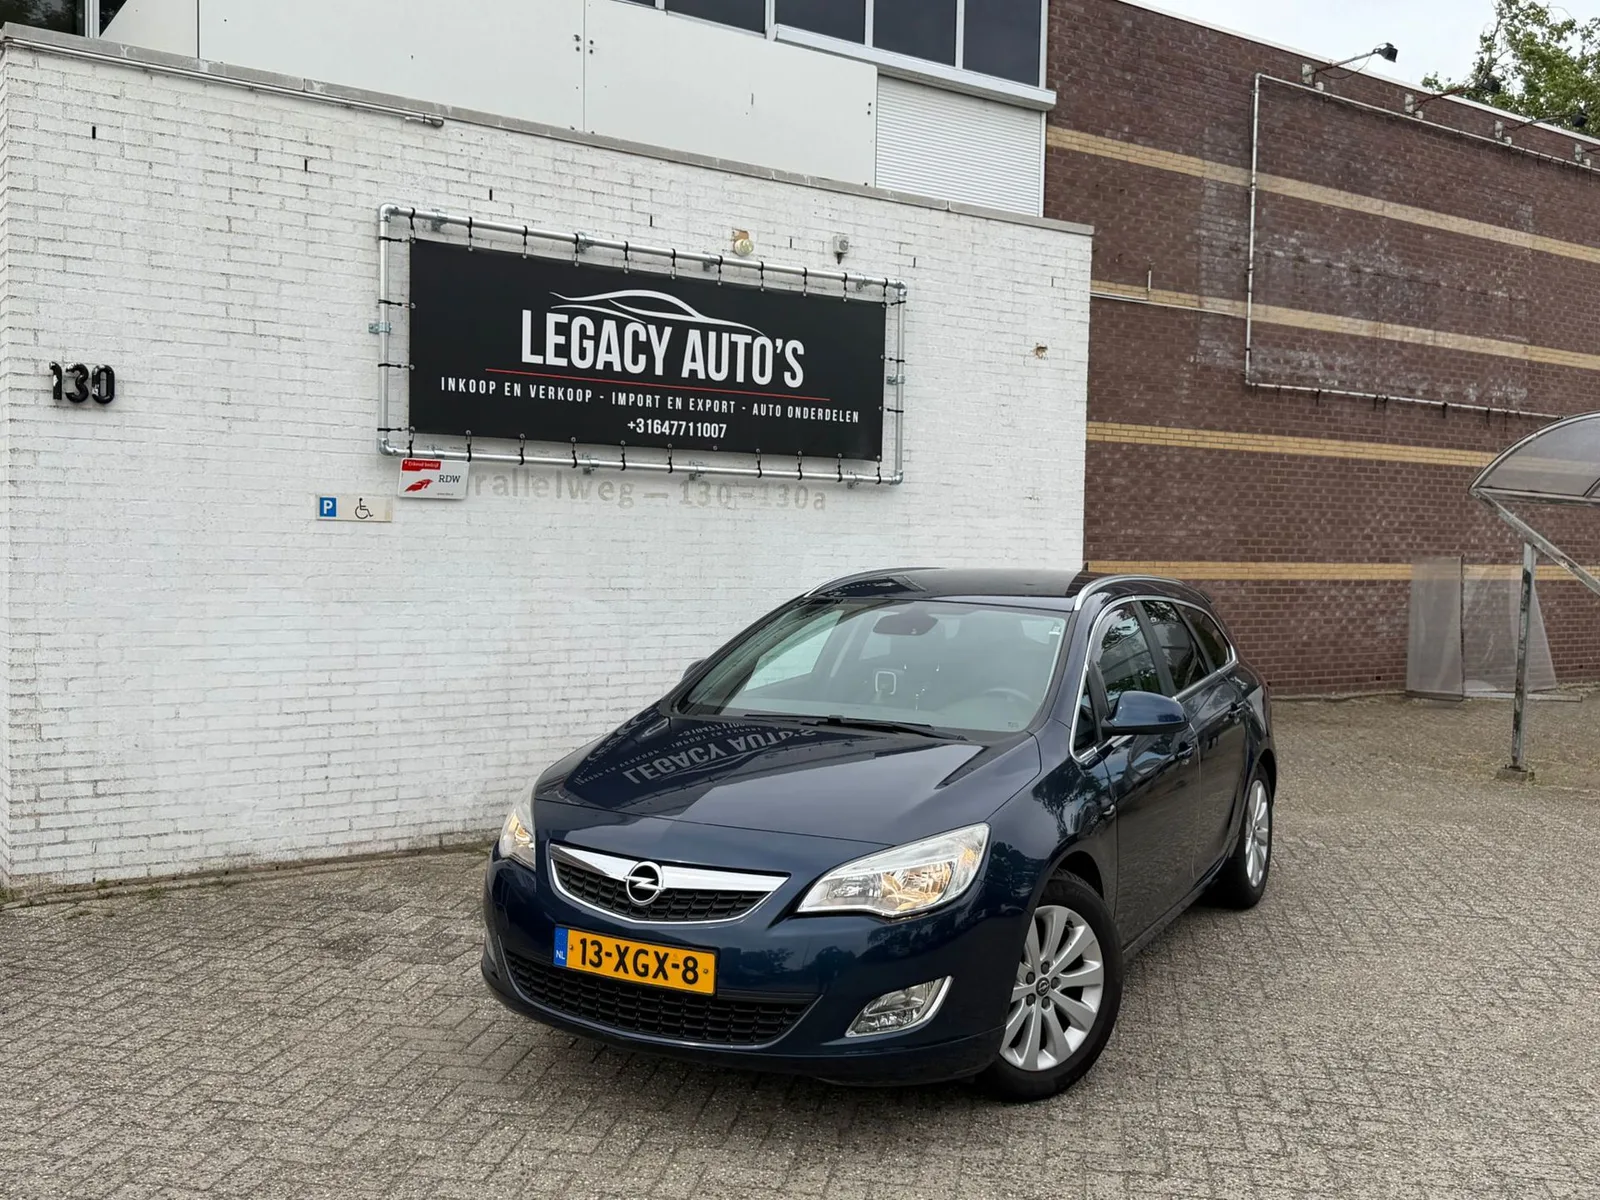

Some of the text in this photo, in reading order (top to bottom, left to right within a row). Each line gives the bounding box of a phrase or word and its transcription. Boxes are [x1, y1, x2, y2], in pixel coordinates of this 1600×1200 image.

[522, 309, 805, 388] LEGACY AUTO'S
[49, 361, 115, 405] 130
[441, 376, 497, 395] INKOOP
[504, 382, 521, 397] EN
[529, 384, 592, 403] VERKOOP
[612, 391, 661, 408] IMPORT
[667, 396, 682, 410] EN
[689, 398, 736, 414] EXPORT
[752, 403, 782, 417] AUTO
[787, 406, 859, 423] ONDERDELEN
[627, 418, 727, 438] +31647711007
[438, 474, 461, 484] RDW
[474, 467, 635, 510] rallelweg
[323, 500, 334, 515] P
[555, 949, 566, 961] NL
[579, 937, 699, 985] 13-XGX-8
